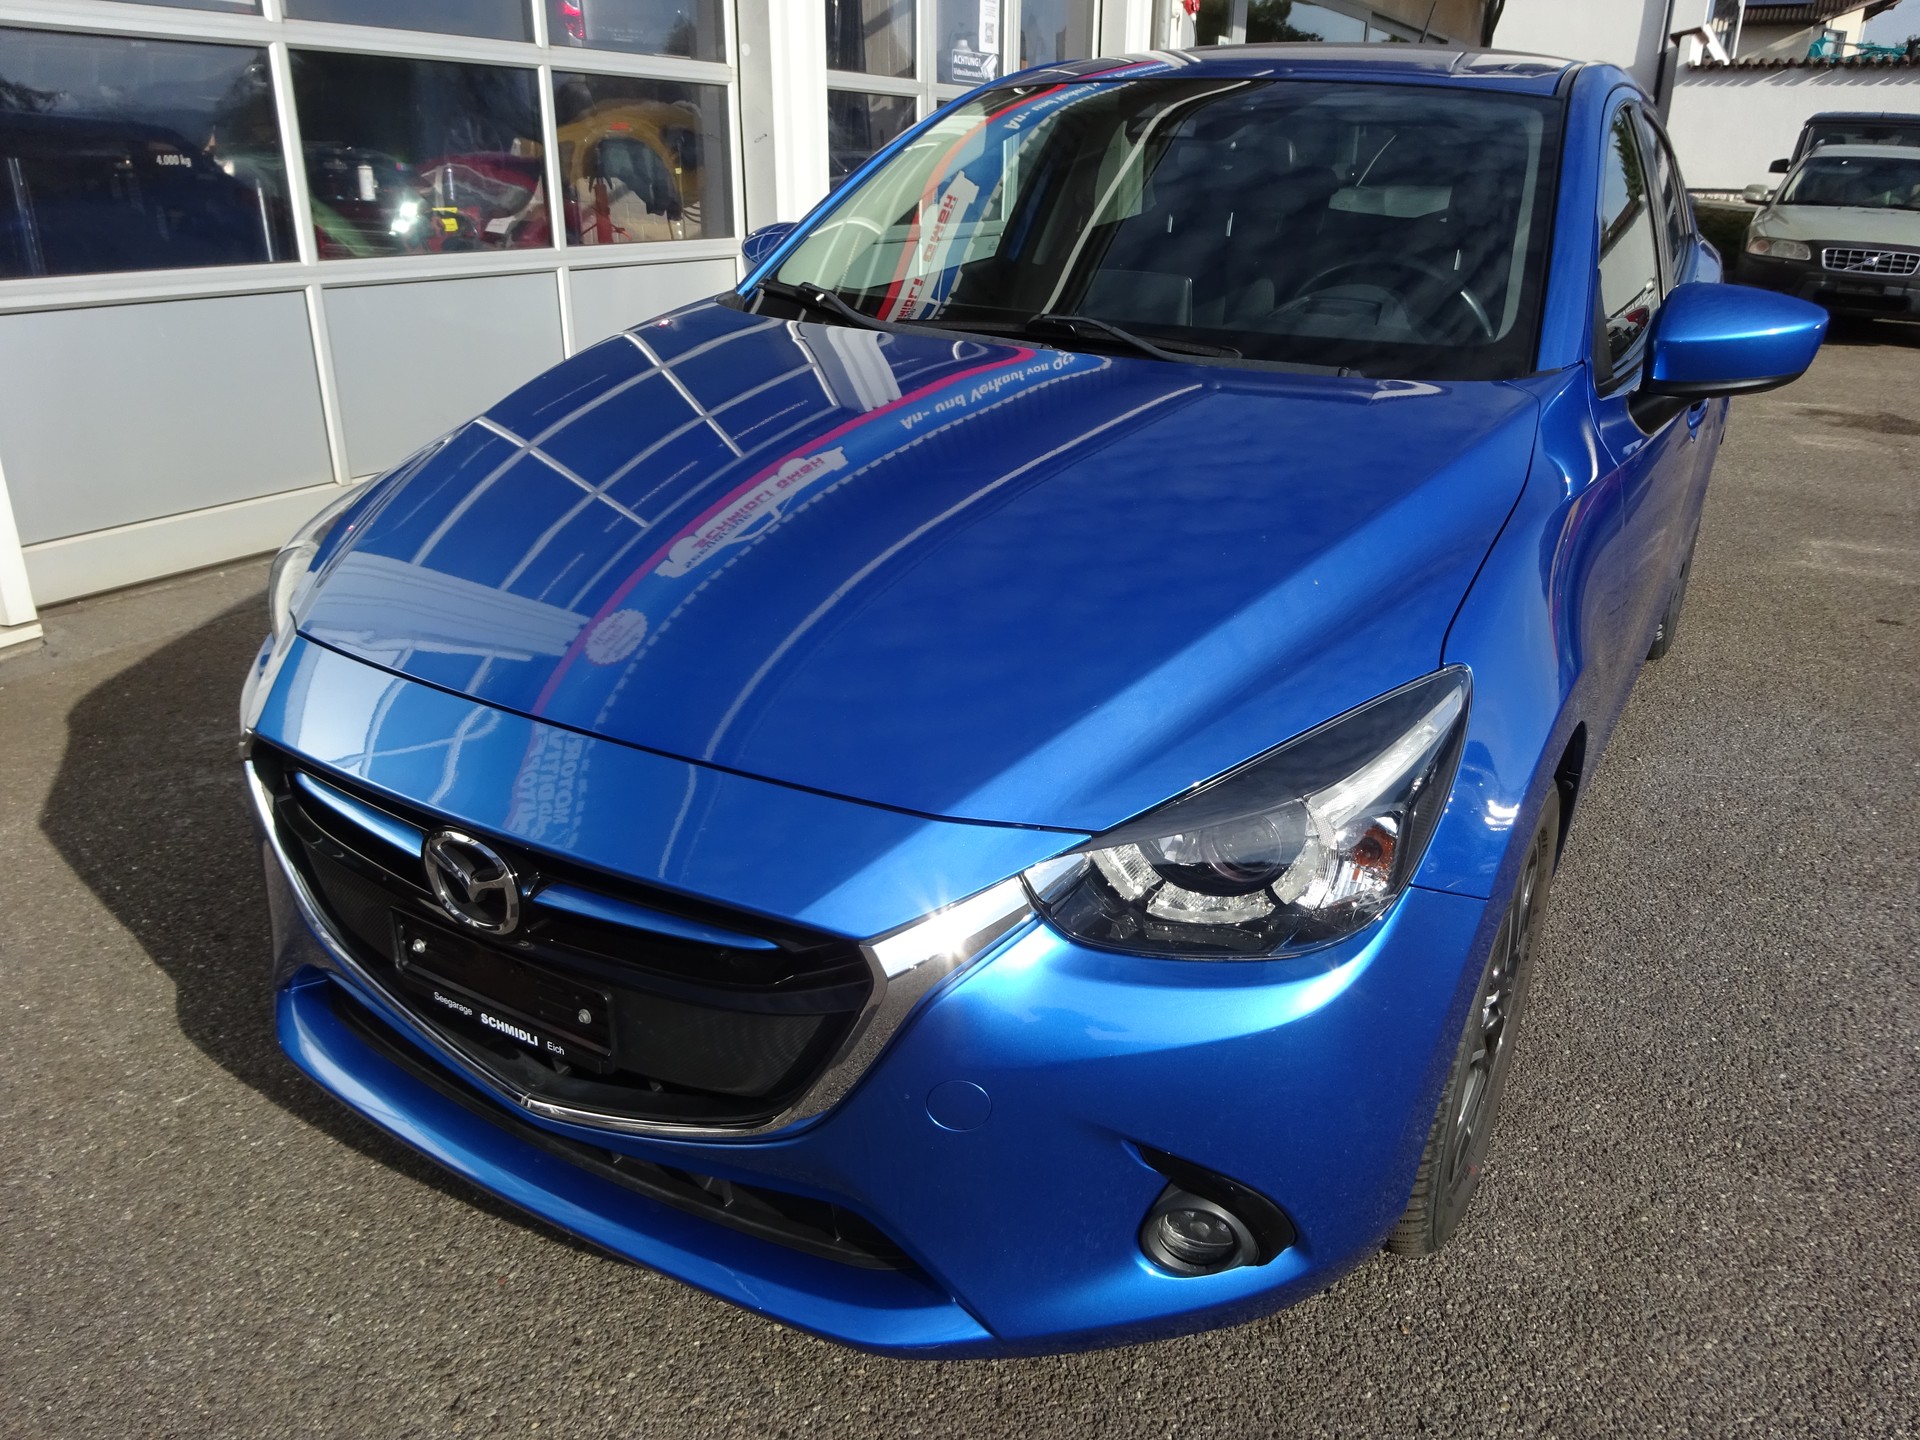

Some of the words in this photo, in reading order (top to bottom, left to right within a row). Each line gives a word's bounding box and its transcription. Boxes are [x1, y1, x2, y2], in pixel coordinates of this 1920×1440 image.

[434, 991, 473, 1016] Seegarage
[480, 1013, 539, 1046] SCHMIDLI
[547, 1041, 565, 1056] Eich
